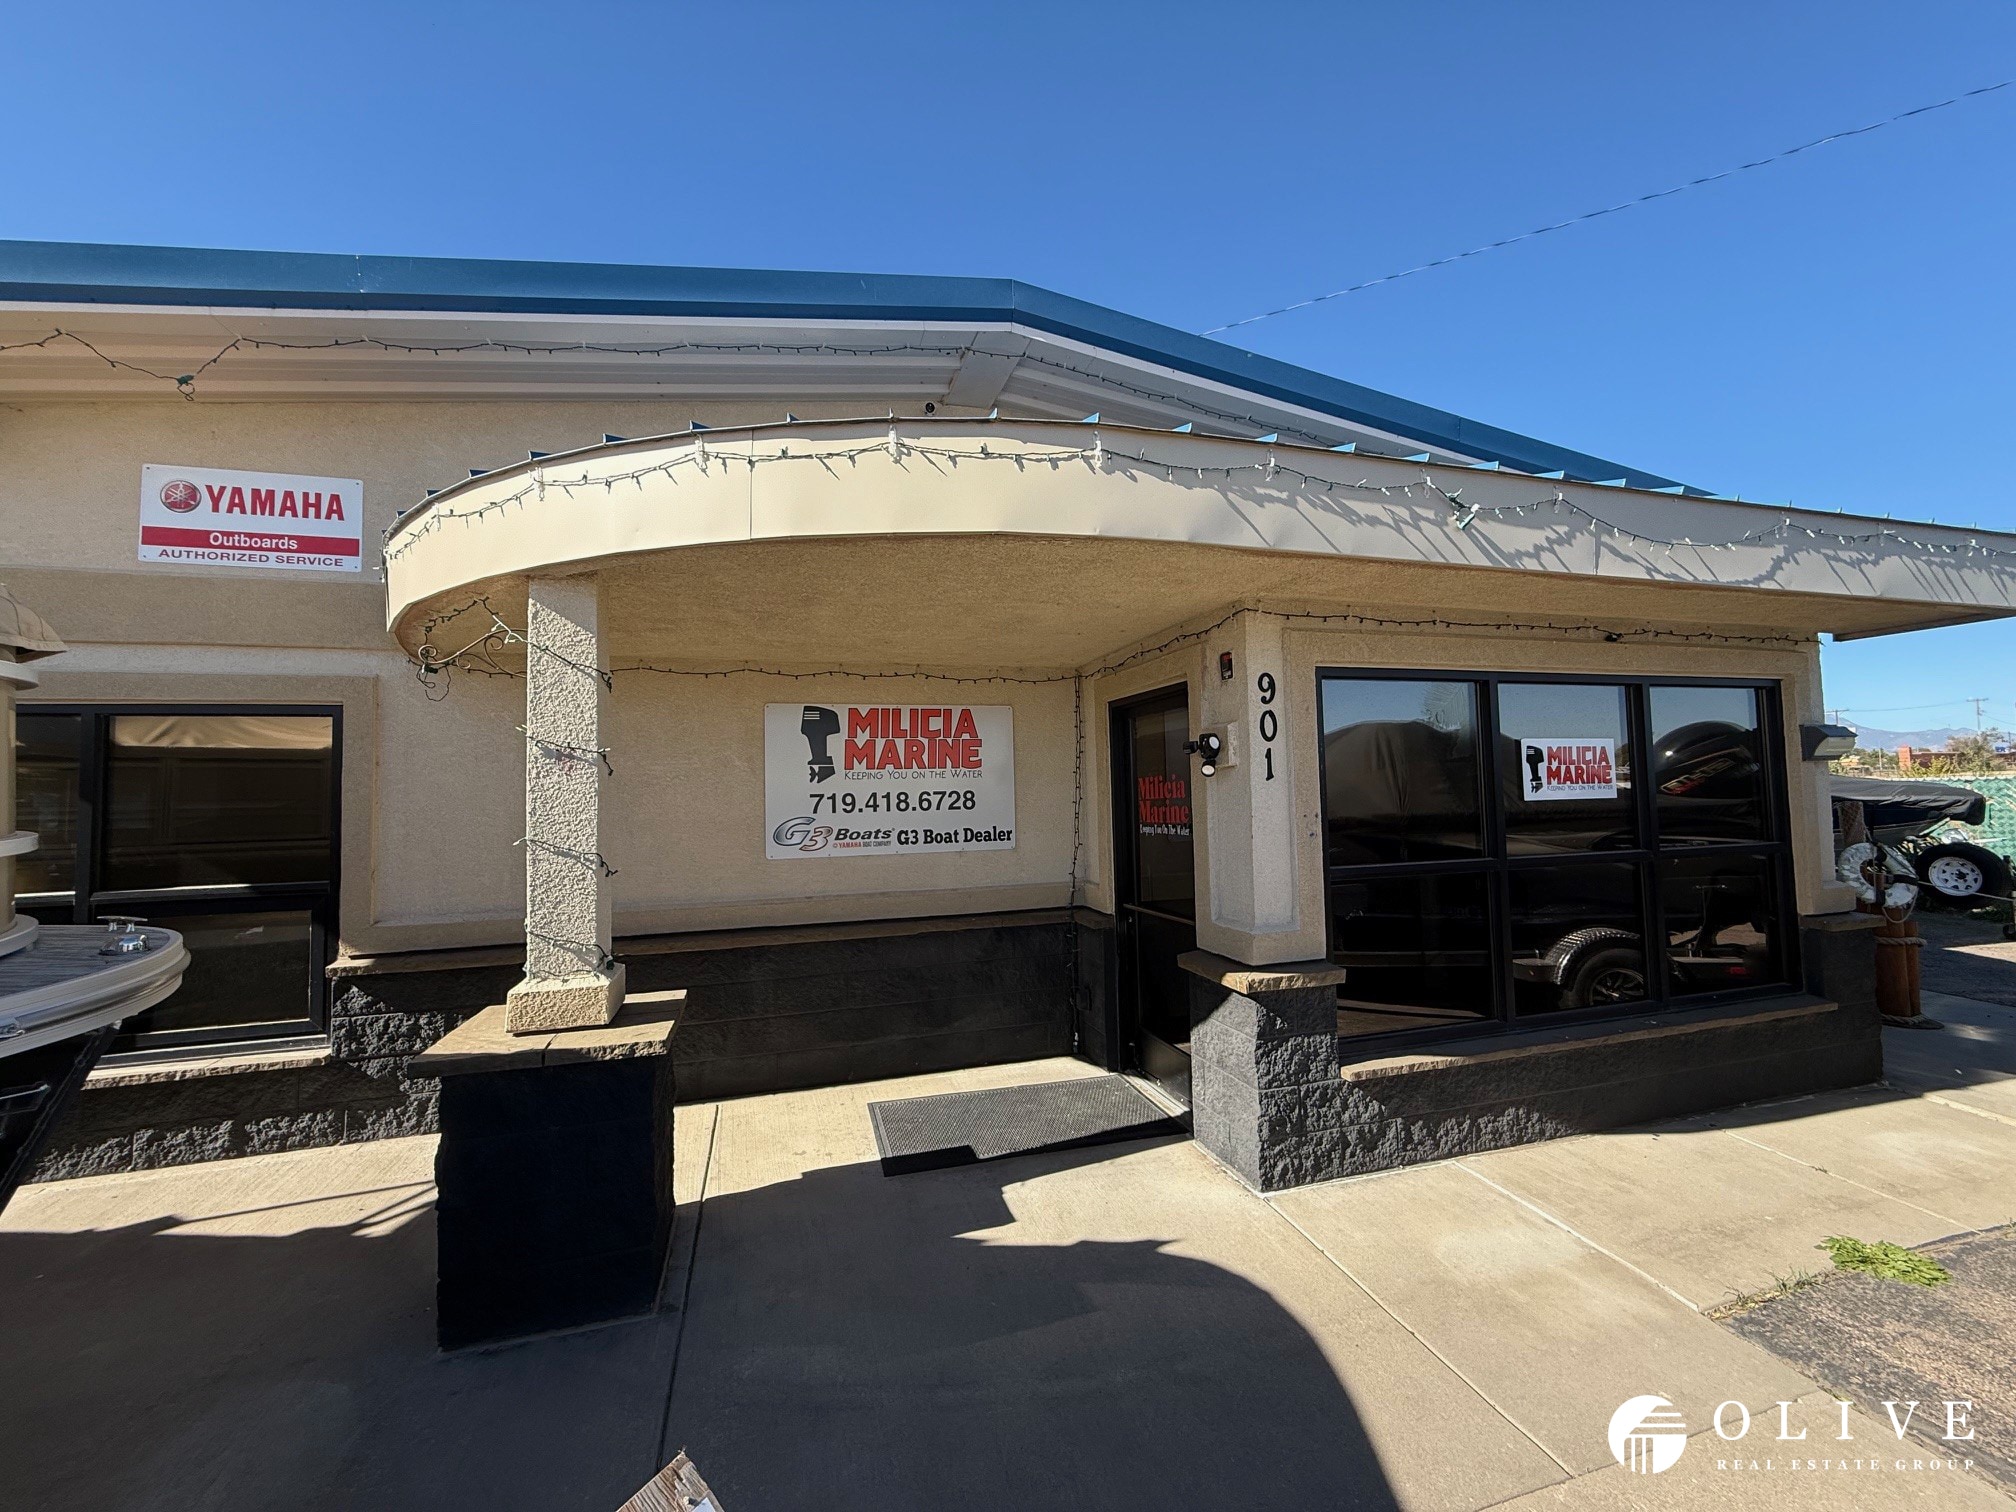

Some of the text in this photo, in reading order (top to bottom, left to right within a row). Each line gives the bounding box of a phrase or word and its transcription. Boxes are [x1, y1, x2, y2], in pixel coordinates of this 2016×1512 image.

[204, 484, 345, 521] YAMAHA
[209, 532, 298, 550] Outboards
[158, 549, 344, 567] AUTHORIZED SERVICE
[847, 707, 979, 738] MILICIA
[844, 738, 983, 770] MARINE
[1546, 745, 1611, 766] MILICIA
[1138, 774, 1186, 799] Milicia
[1546, 764, 1613, 785] MARINE
[809, 790, 977, 815] 719.418.6728
[1139, 799, 1189, 823] Marine
[772, 816, 893, 852] G3 Boats
[839, 841, 862, 849] YAMAHA
[896, 825, 1013, 846] G3 Boat Dealer
